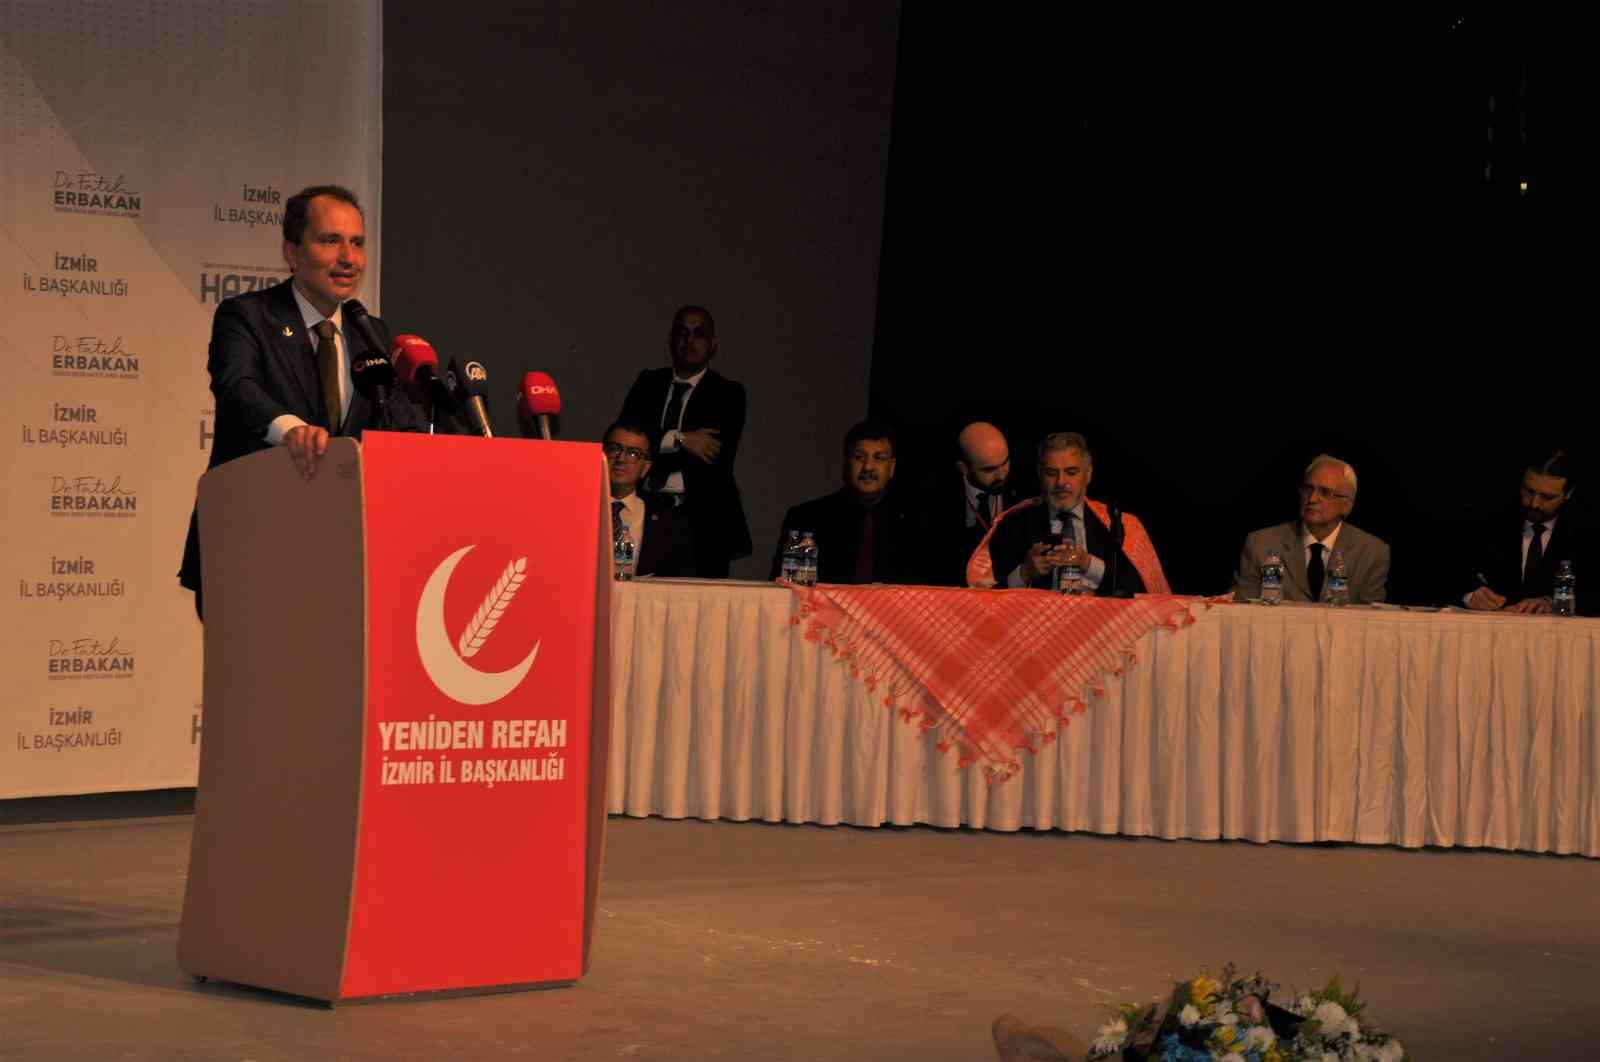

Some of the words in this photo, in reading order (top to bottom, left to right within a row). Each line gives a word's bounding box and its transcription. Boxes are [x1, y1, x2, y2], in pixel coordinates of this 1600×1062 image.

[54, 191, 141, 210] ERBAKAN
[244, 184, 280, 205] İZMİR
[214, 203, 226, 222] İL
[55, 252, 98, 273] İZMİR
[24, 273, 37, 292] İL
[40, 276, 128, 297] BAŞKANLIĞI
[53, 355, 138, 372] ERBAKAN
[54, 403, 97, 423] İZMİR
[23, 425, 36, 444] İL
[39, 426, 127, 449] BAŞKANLIĞI
[51, 495, 137, 511] ERBAKAN
[51, 556, 94, 576] İZMİR
[20, 580, 33, 598] İL
[36, 579, 125, 602] BAŞKANLIĞI
[49, 657, 134, 674] ERBAKAN
[49, 706, 92, 727] İZMİR
[17, 733, 30, 751] İL
[33, 730, 121, 753] BAŞKANLIĞI
[379, 714, 484, 751] YENİDEN
[492, 719, 567, 749] REFAH
[381, 755, 434, 786] İZMİR
[440, 755, 456, 784] İL
[461, 752, 565, 789] BAŞKANLIĞI
